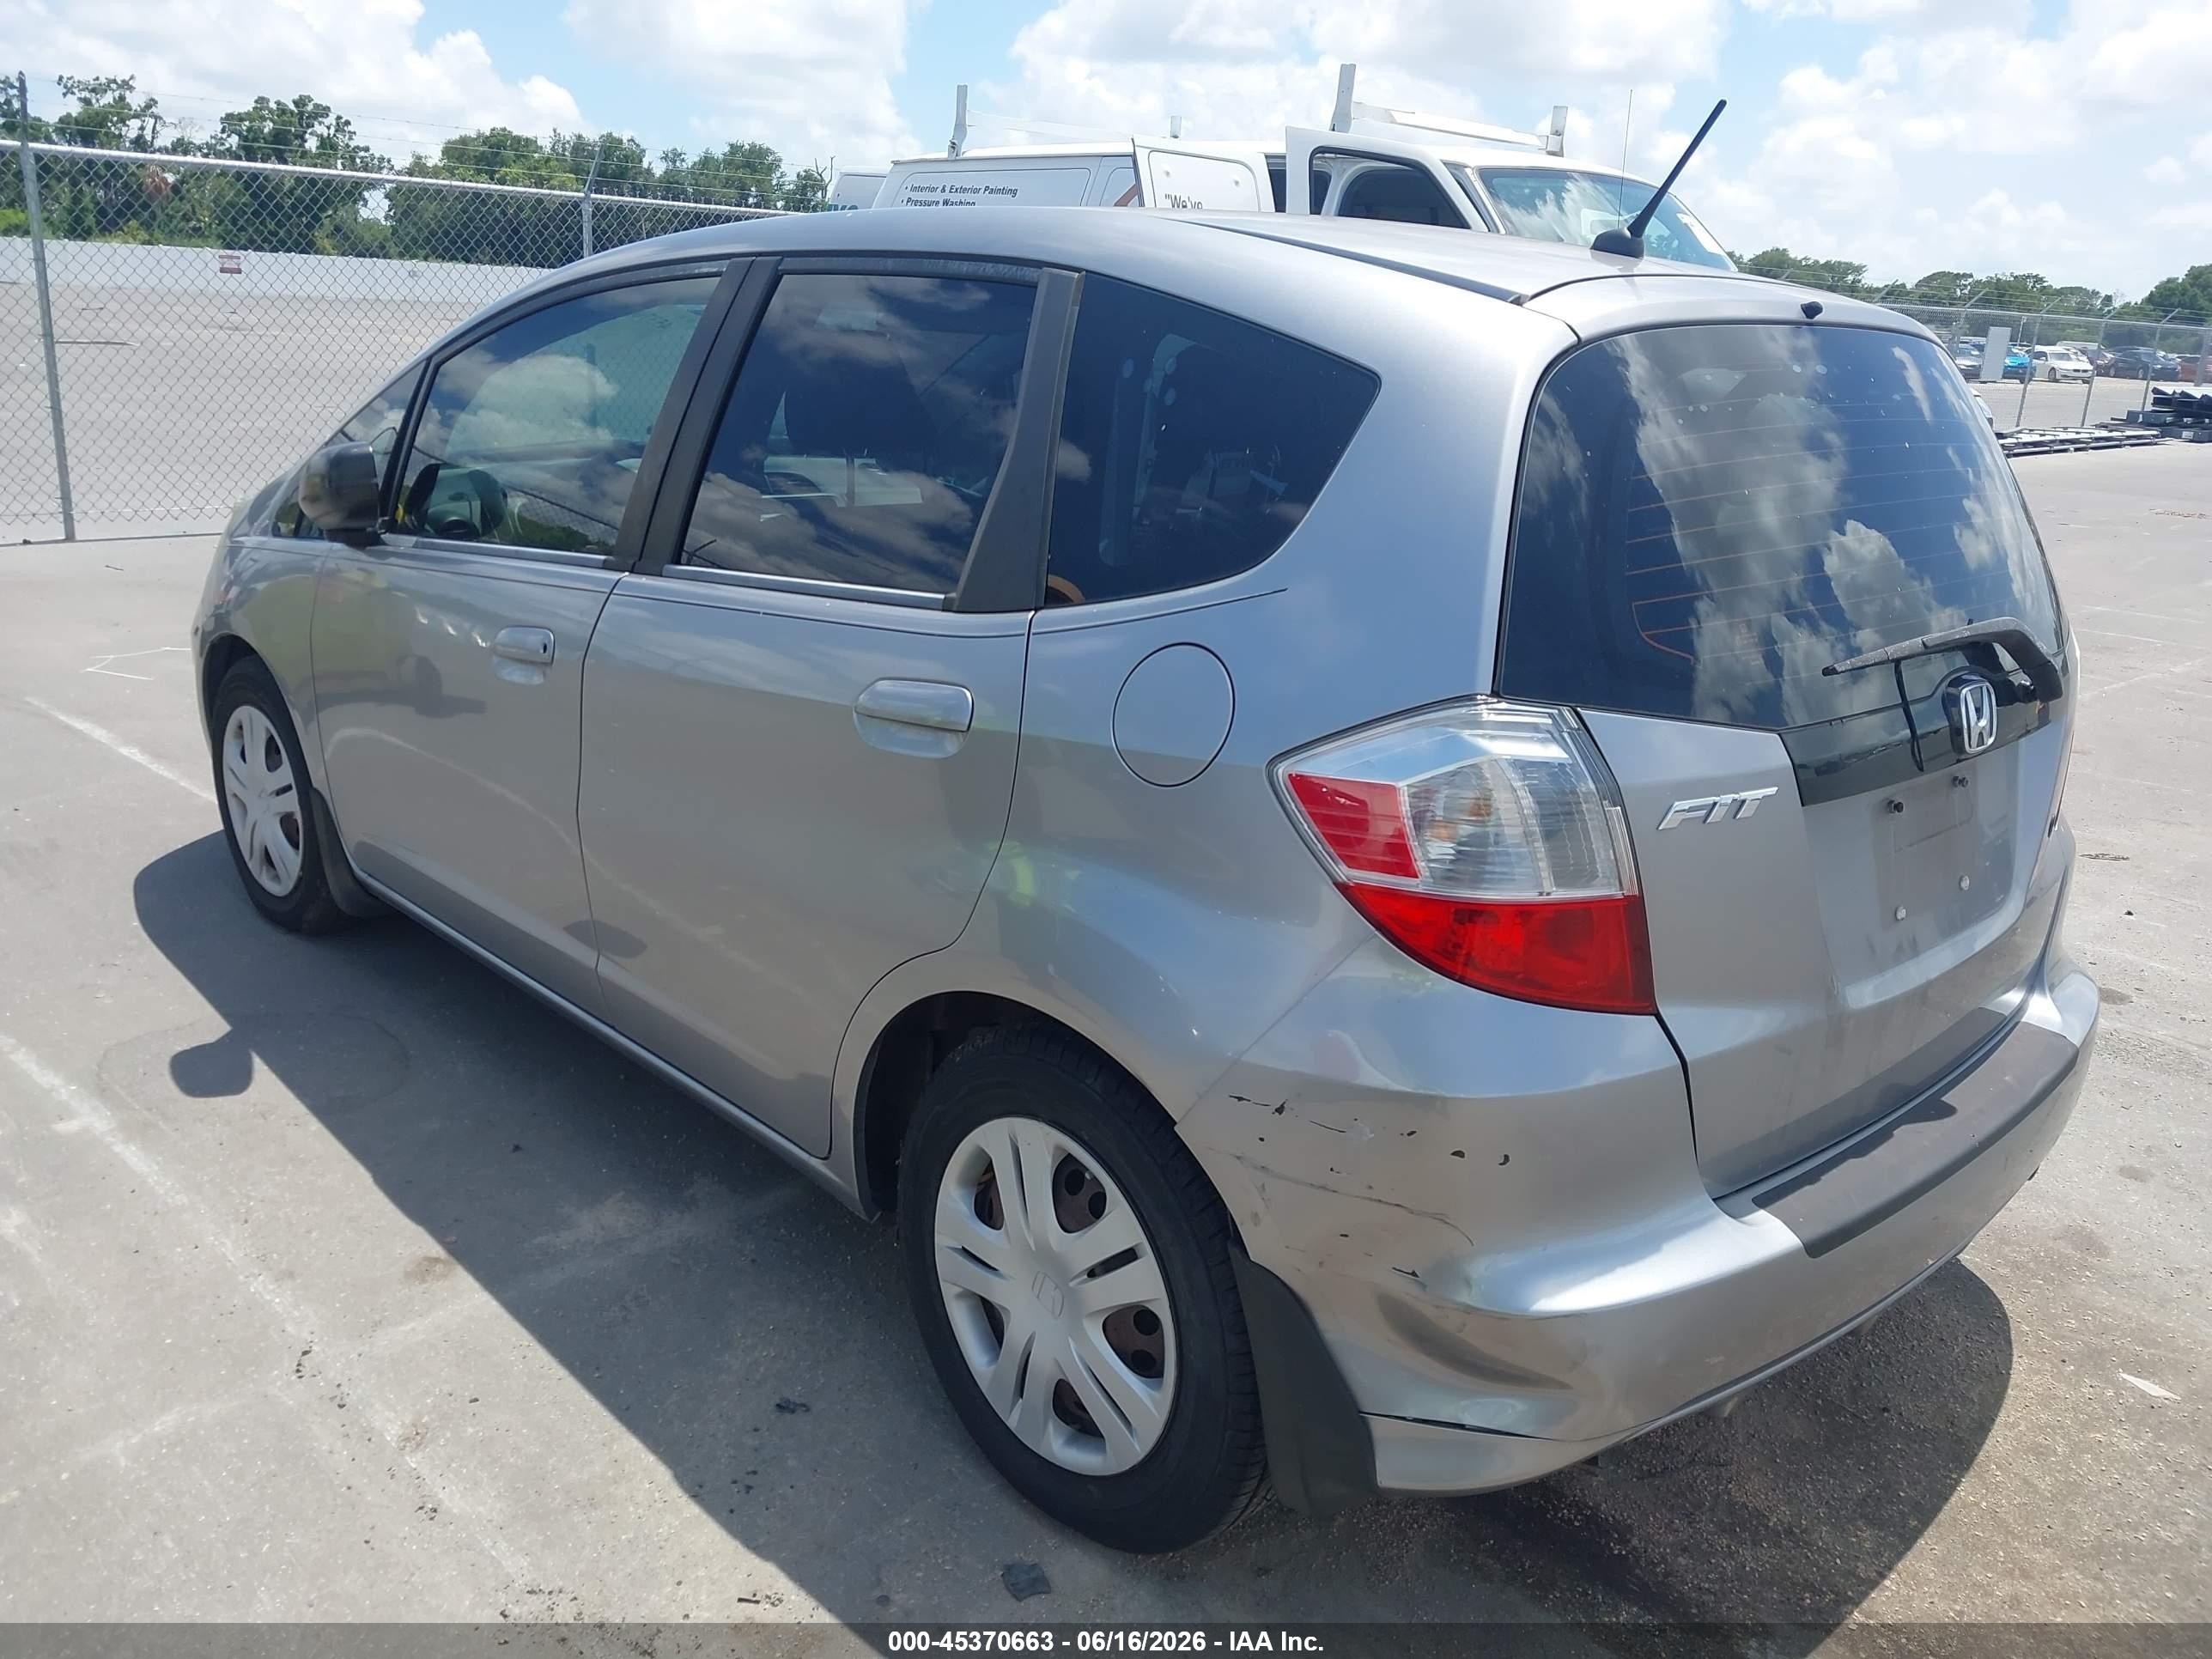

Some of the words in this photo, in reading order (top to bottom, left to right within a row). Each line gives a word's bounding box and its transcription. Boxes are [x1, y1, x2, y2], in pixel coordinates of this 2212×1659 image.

[909, 184, 939, 193] Interior
[940, 185, 947, 193] &
[948, 185, 981, 194] Exterior
[982, 185, 1018, 198] Painting
[905, 198, 940, 207] Pressure
[1656, 787, 1779, 830] FIT
